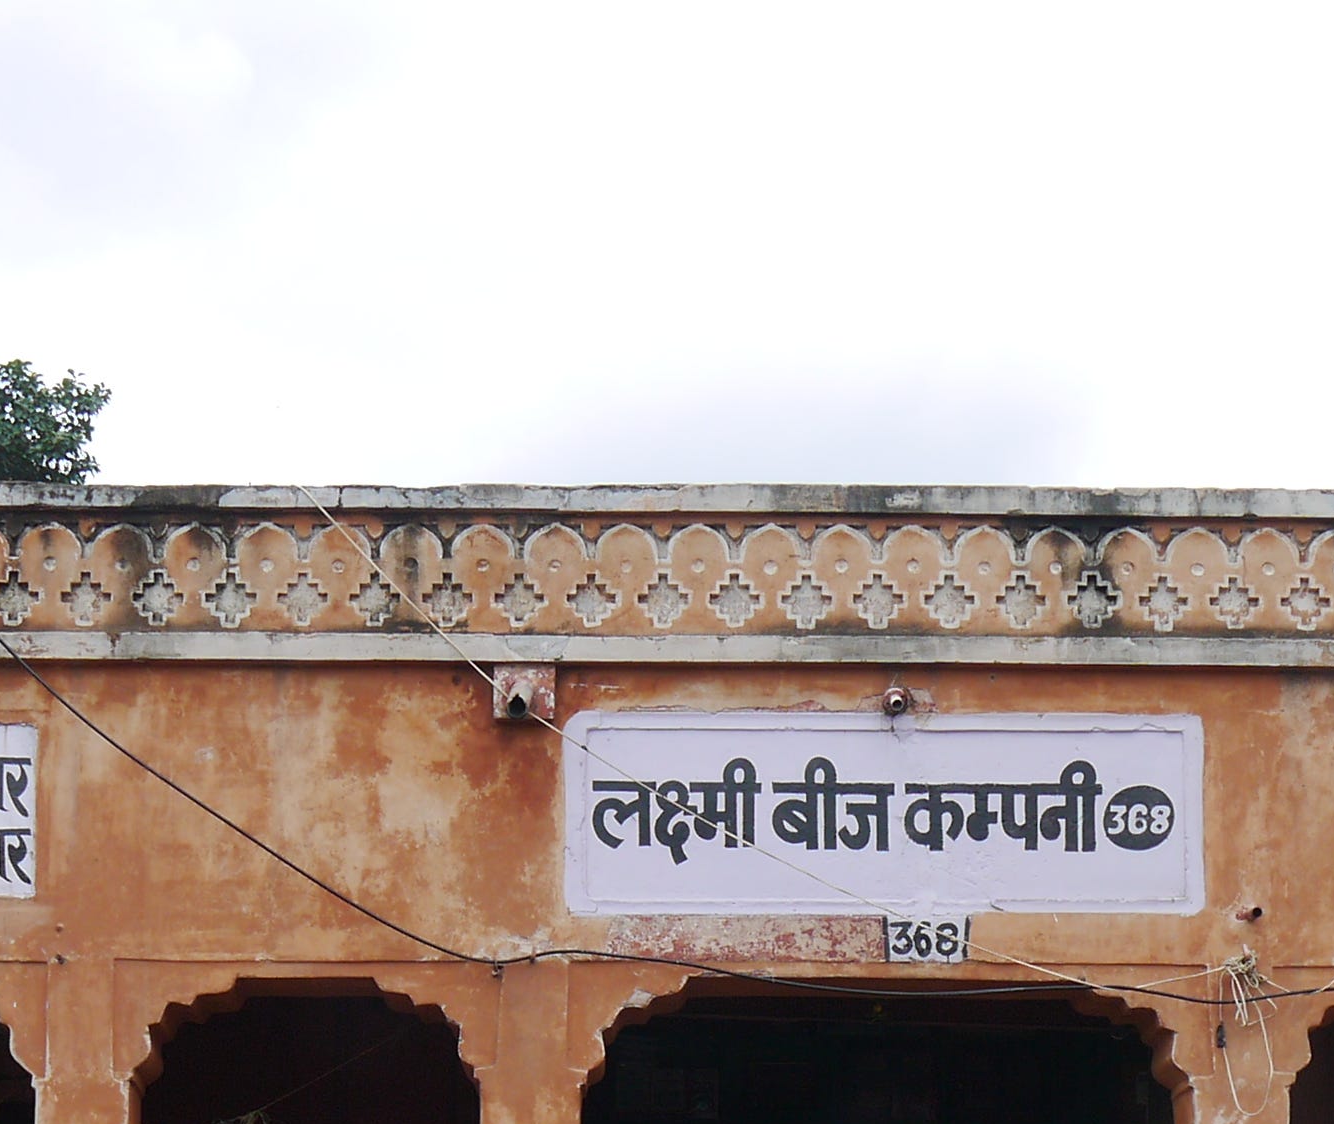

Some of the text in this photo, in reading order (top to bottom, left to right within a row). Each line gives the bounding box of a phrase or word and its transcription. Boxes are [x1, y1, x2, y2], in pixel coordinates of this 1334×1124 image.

[592, 757, 1172, 865] लक्ष्मी बीज कम्पनी 368
[891, 920, 959, 958] 368
